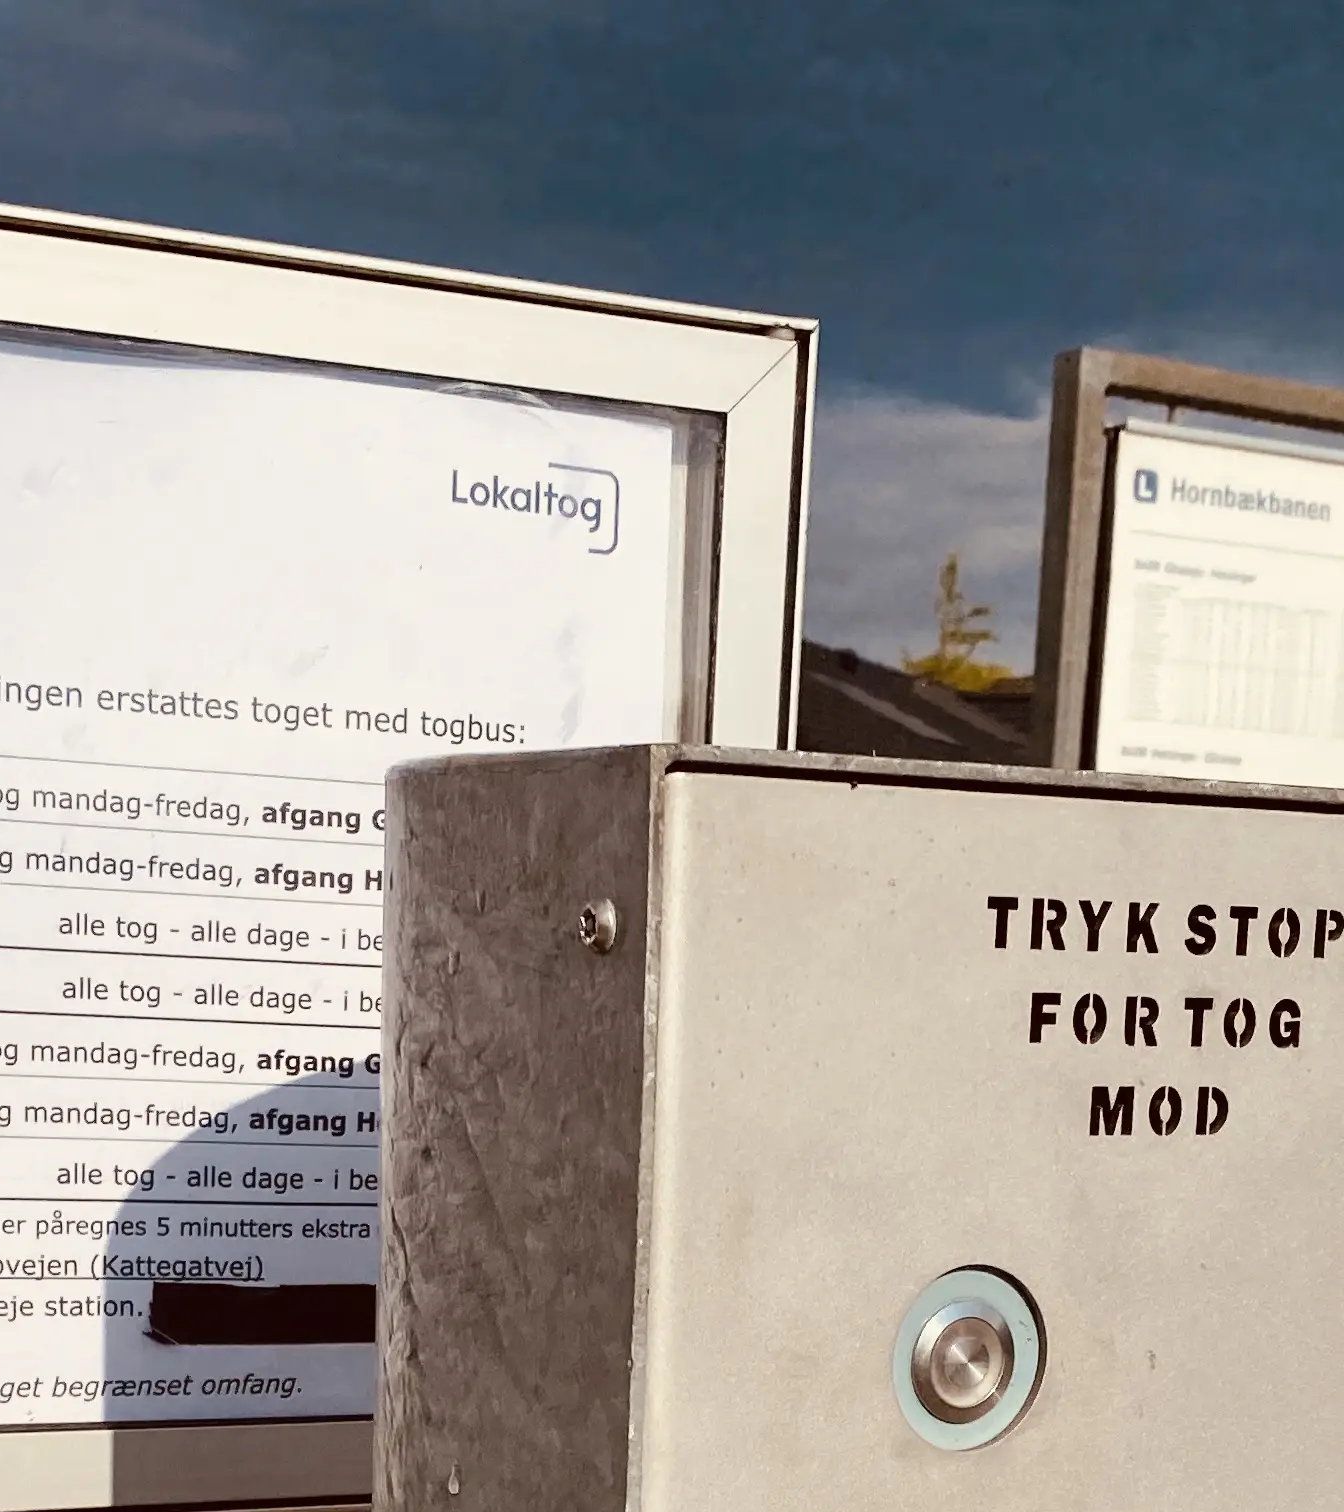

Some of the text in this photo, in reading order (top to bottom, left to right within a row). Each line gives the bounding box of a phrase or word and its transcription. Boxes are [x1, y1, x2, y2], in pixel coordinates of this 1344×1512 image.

[451, 469, 602, 533] Lokaltog
[1171, 477, 1330, 523] Hornbækbanen
[97, 680, 239, 722] erstattes
[251, 695, 333, 735] toget
[344, 704, 408, 736] med
[420, 712, 526, 746] togbus:
[33, 789, 250, 827] mandag-fredag,
[262, 803, 361, 833] afgang
[26, 851, 242, 887] mandag-fredag,
[254, 864, 353, 894] afgang
[58, 913, 105, 937] alle
[116, 915, 158, 944] tog
[191, 919, 237, 944] alle
[247, 923, 310, 952] dage
[987, 896, 1344, 958] TRYK STOP
[62, 977, 109, 1001] alle
[120, 981, 161, 1008] tog
[194, 983, 239, 1007] alle
[250, 986, 313, 1014] dage
[1029, 992, 1300, 1048] FOR TOG
[31, 1042, 245, 1074] mandag-fredag,
[257, 1051, 355, 1077] afgang
[24, 1103, 239, 1134] mandag-fredag,
[249, 1110, 347, 1136] afgang
[1089, 1086, 1228, 1136] MOD
[57, 1162, 102, 1185] alle
[114, 1164, 155, 1191] tog
[187, 1165, 232, 1188] alle
[242, 1167, 303, 1193] dage
[36, 1210, 146, 1239] påregnes
[157, 1217, 170, 1236] 5
[180, 1218, 292, 1238] minutters
[302, 1219, 370, 1238] ekstra
[91, 1255, 263, 1280] (Kattegatvej)
[45, 1296, 143, 1316] station.
[52, 1376, 193, 1398] begrænset
[202, 1375, 301, 1397] omfang.
